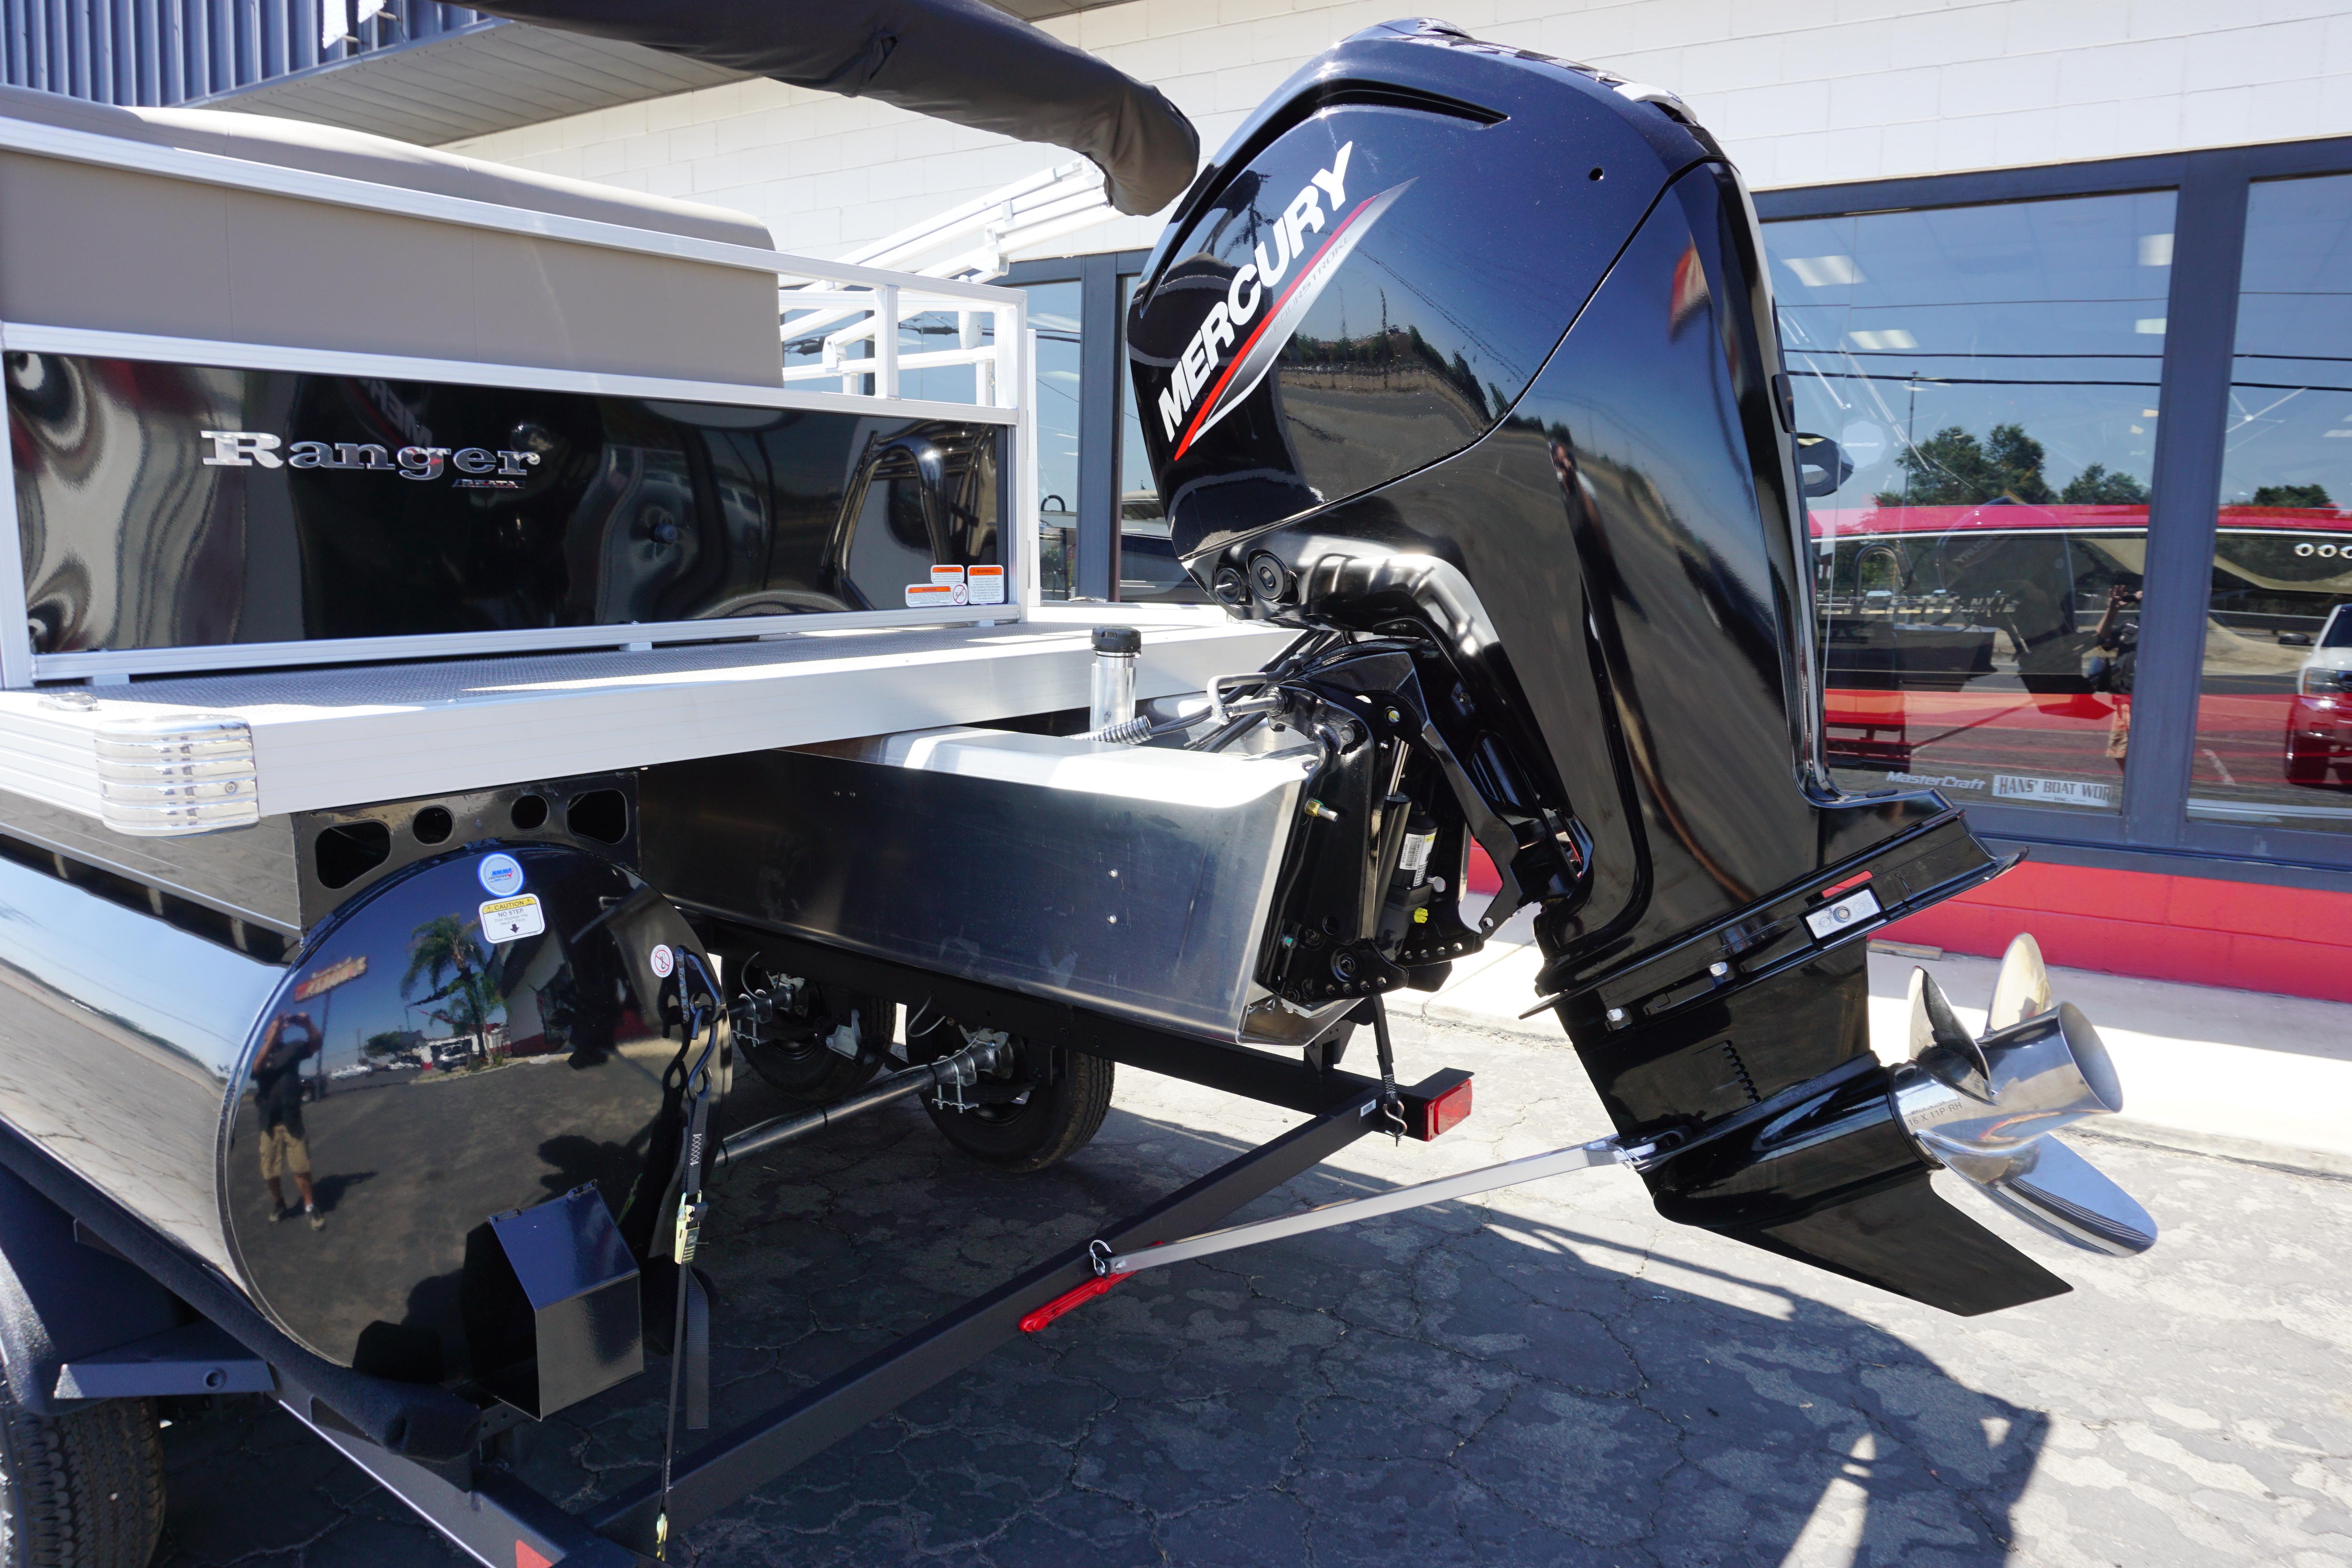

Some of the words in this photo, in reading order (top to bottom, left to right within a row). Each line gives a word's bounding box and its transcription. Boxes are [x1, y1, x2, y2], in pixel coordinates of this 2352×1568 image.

[1158, 140, 1353, 443] MERCURY
[1272, 230, 1352, 333] FOURSTROKE
[200, 430, 541, 480] Ranger
[1886, 771, 1987, 790] MasterCraft
[2000, 777, 2038, 794] HANS'
[2043, 780, 2077, 795] BOAT
[495, 900, 524, 910] CAUTION
[1908, 1117, 1919, 1125] 16
[1920, 1113, 1928, 1122] X
[1929, 1107, 1945, 1118] 11P
[1948, 1102, 1963, 1112] RH
